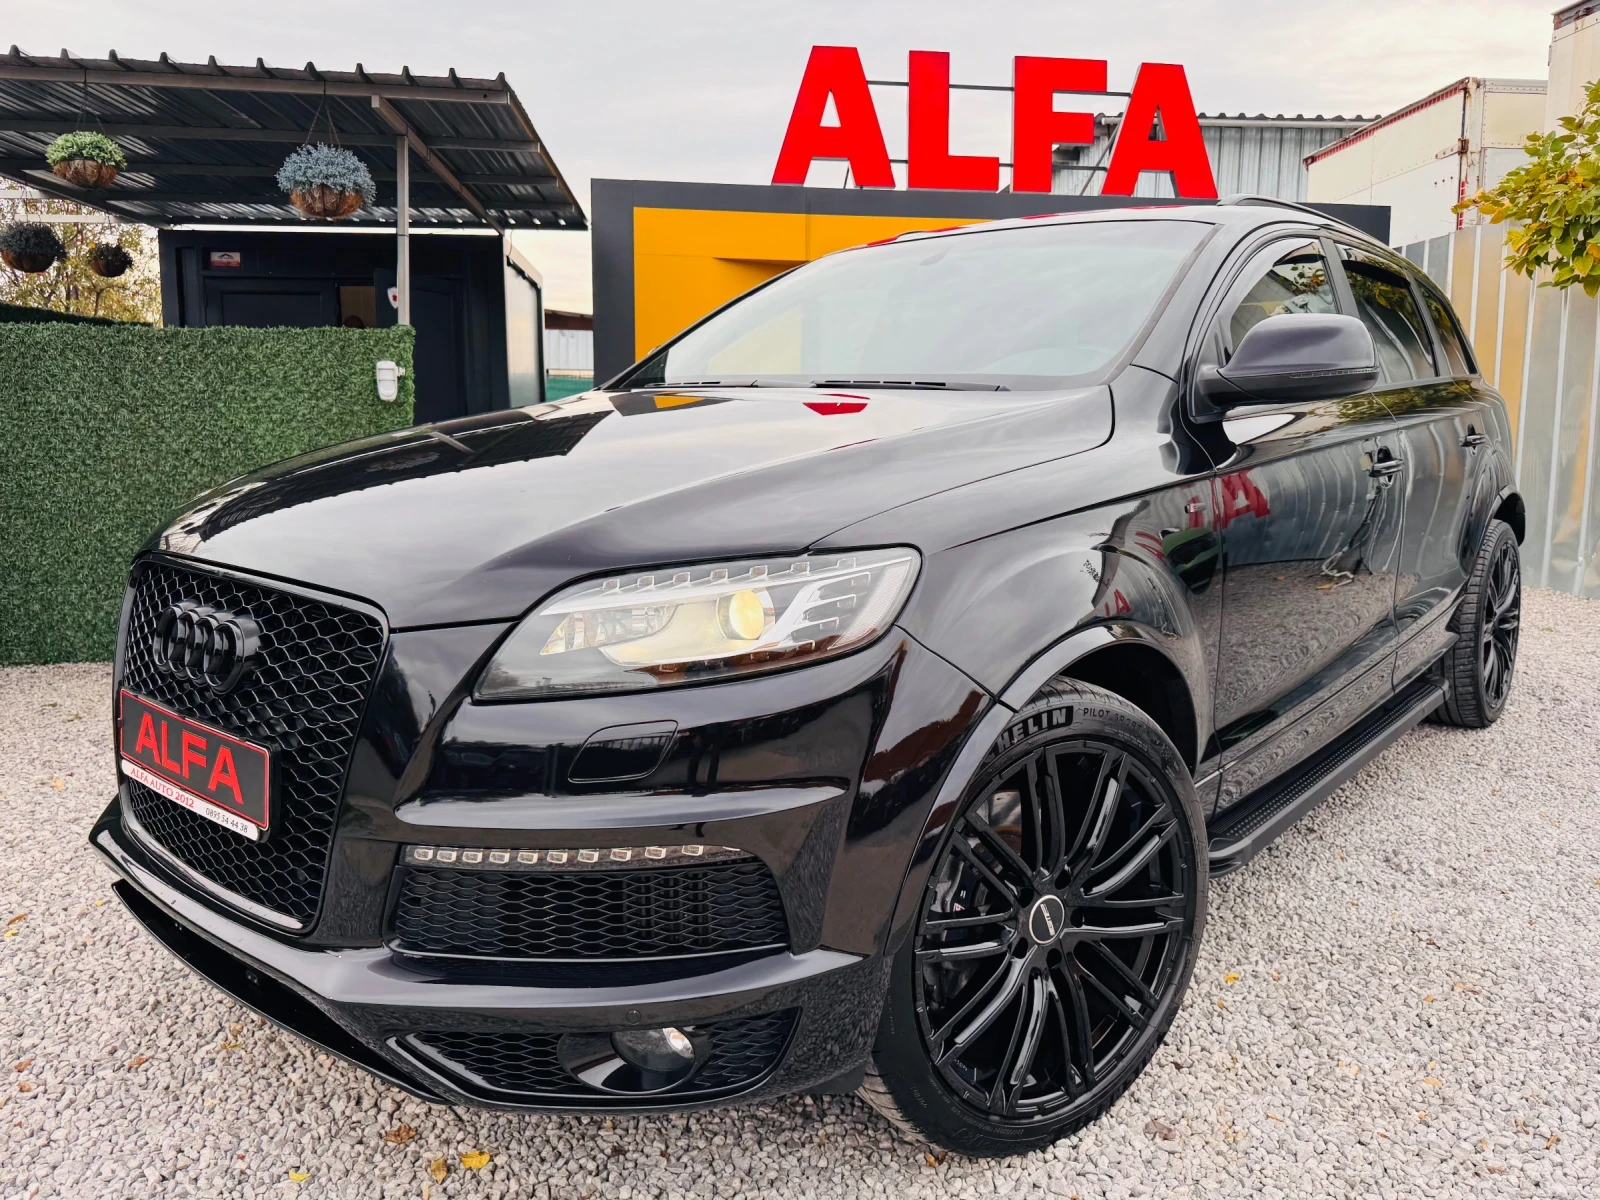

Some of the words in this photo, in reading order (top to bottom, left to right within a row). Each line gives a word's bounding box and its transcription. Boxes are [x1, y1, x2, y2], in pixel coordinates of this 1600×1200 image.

[771, 45, 1219, 199] ALFA
[135, 711, 244, 804] ALFA
[1083, 707, 1110, 718] PILOT
[1115, 713, 1143, 731] SPORT
[130, 767, 149, 784] ALFA
[149, 779, 174, 797] AUTO
[175, 791, 195, 809] 2012
[205, 807, 221, 820] 0895
[220, 814, 229, 825] 54
[230, 819, 239, 829] 44
[239, 822, 248, 833] 38
